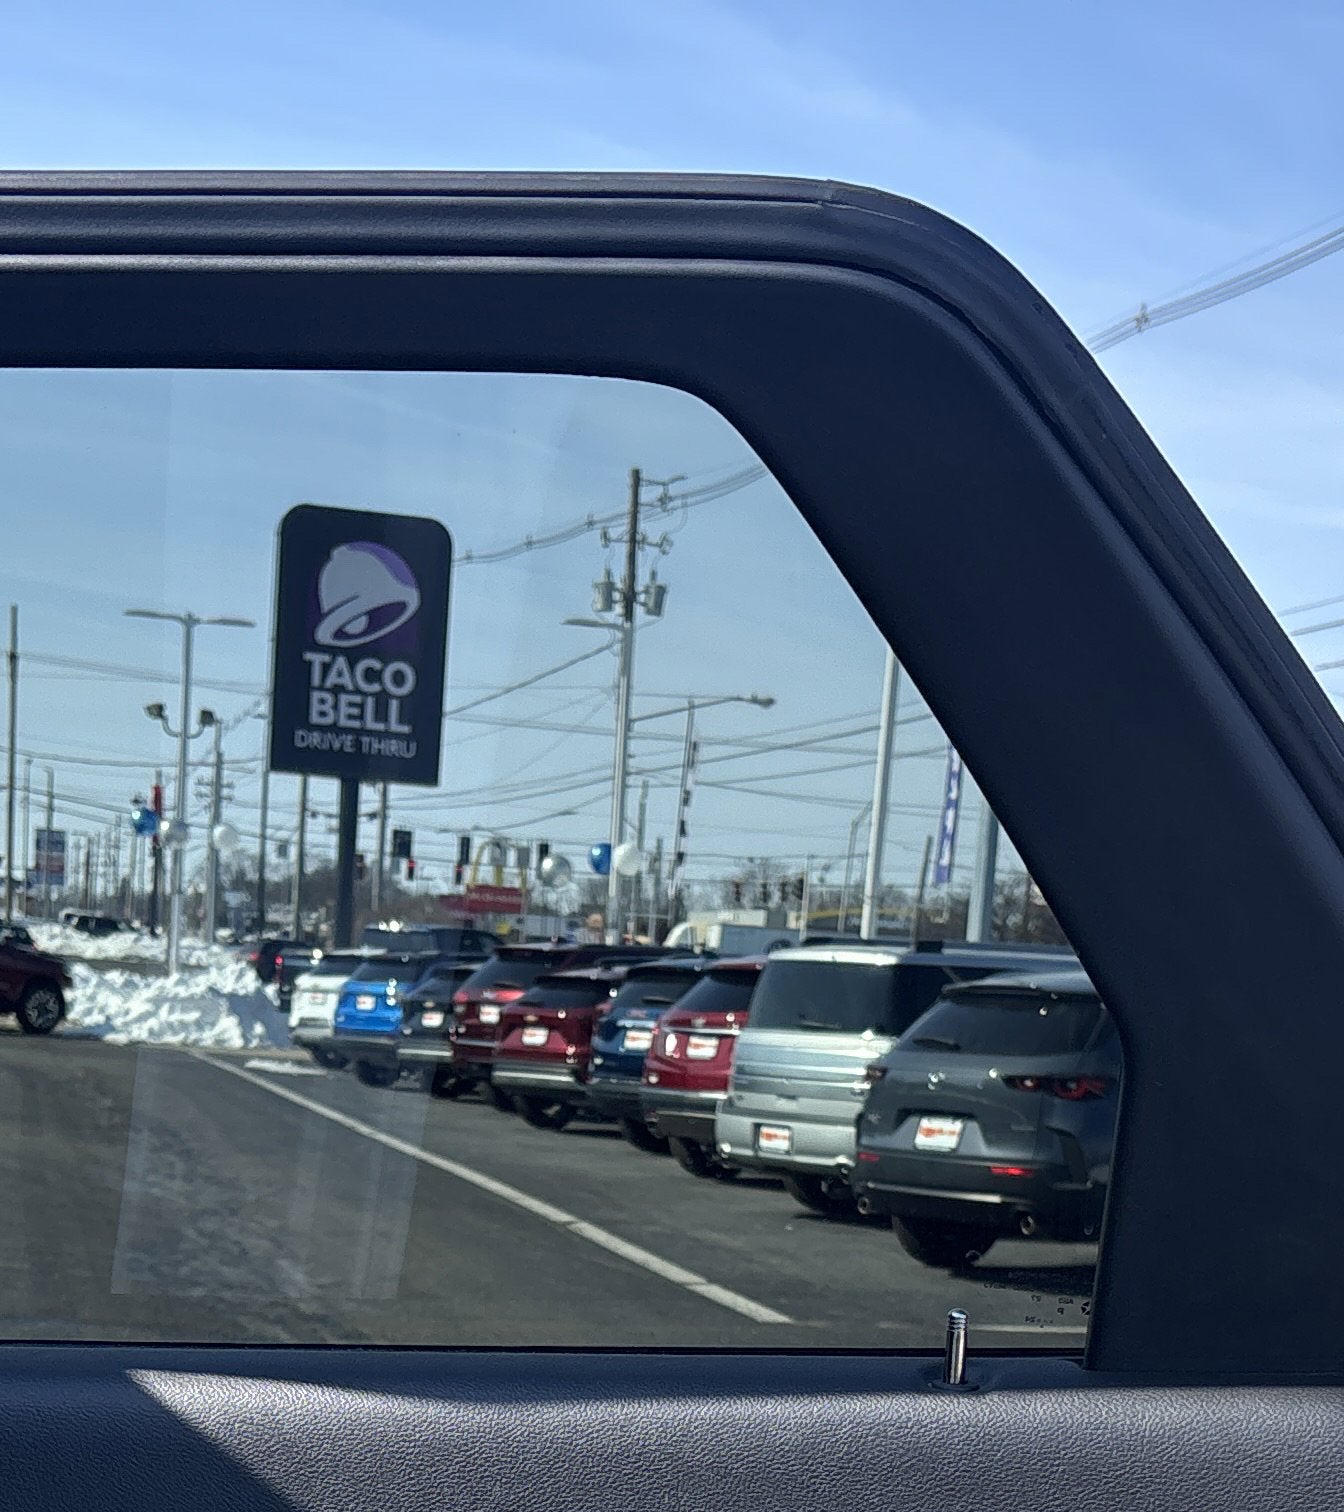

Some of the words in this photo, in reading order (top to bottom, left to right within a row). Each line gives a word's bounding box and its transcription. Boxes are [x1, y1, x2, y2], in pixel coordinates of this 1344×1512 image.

[302, 651, 416, 697] TACO
[308, 689, 413, 734] BELL
[294, 728, 356, 753] DRIVE
[360, 736, 417, 759] THRU
